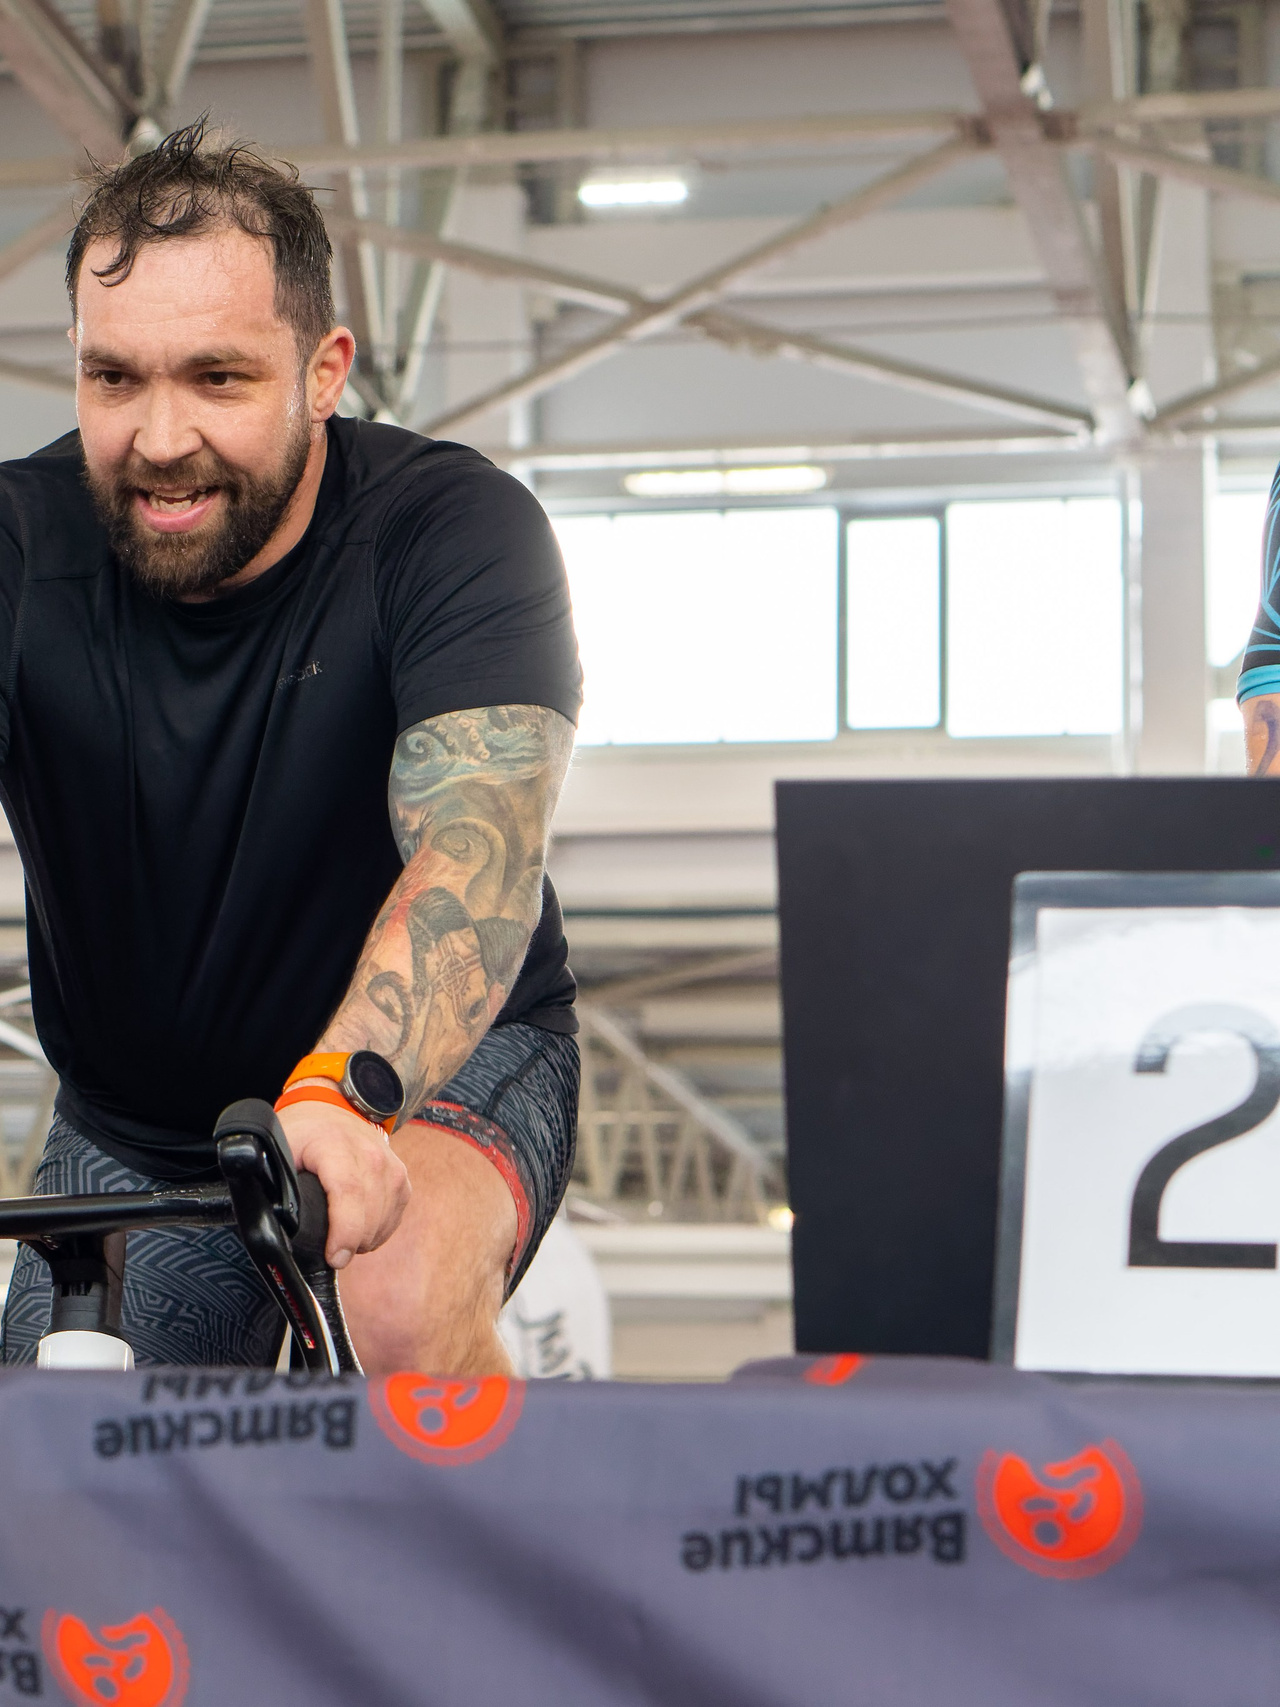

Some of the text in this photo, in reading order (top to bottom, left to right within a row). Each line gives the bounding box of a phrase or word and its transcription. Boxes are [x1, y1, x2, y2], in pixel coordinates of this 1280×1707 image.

[1127, 1002, 1280, 1269] 2
[93, 1400, 357, 1461] Вятские
[734, 1460, 958, 1517] холмы
[682, 1512, 966, 1572] Вятские
